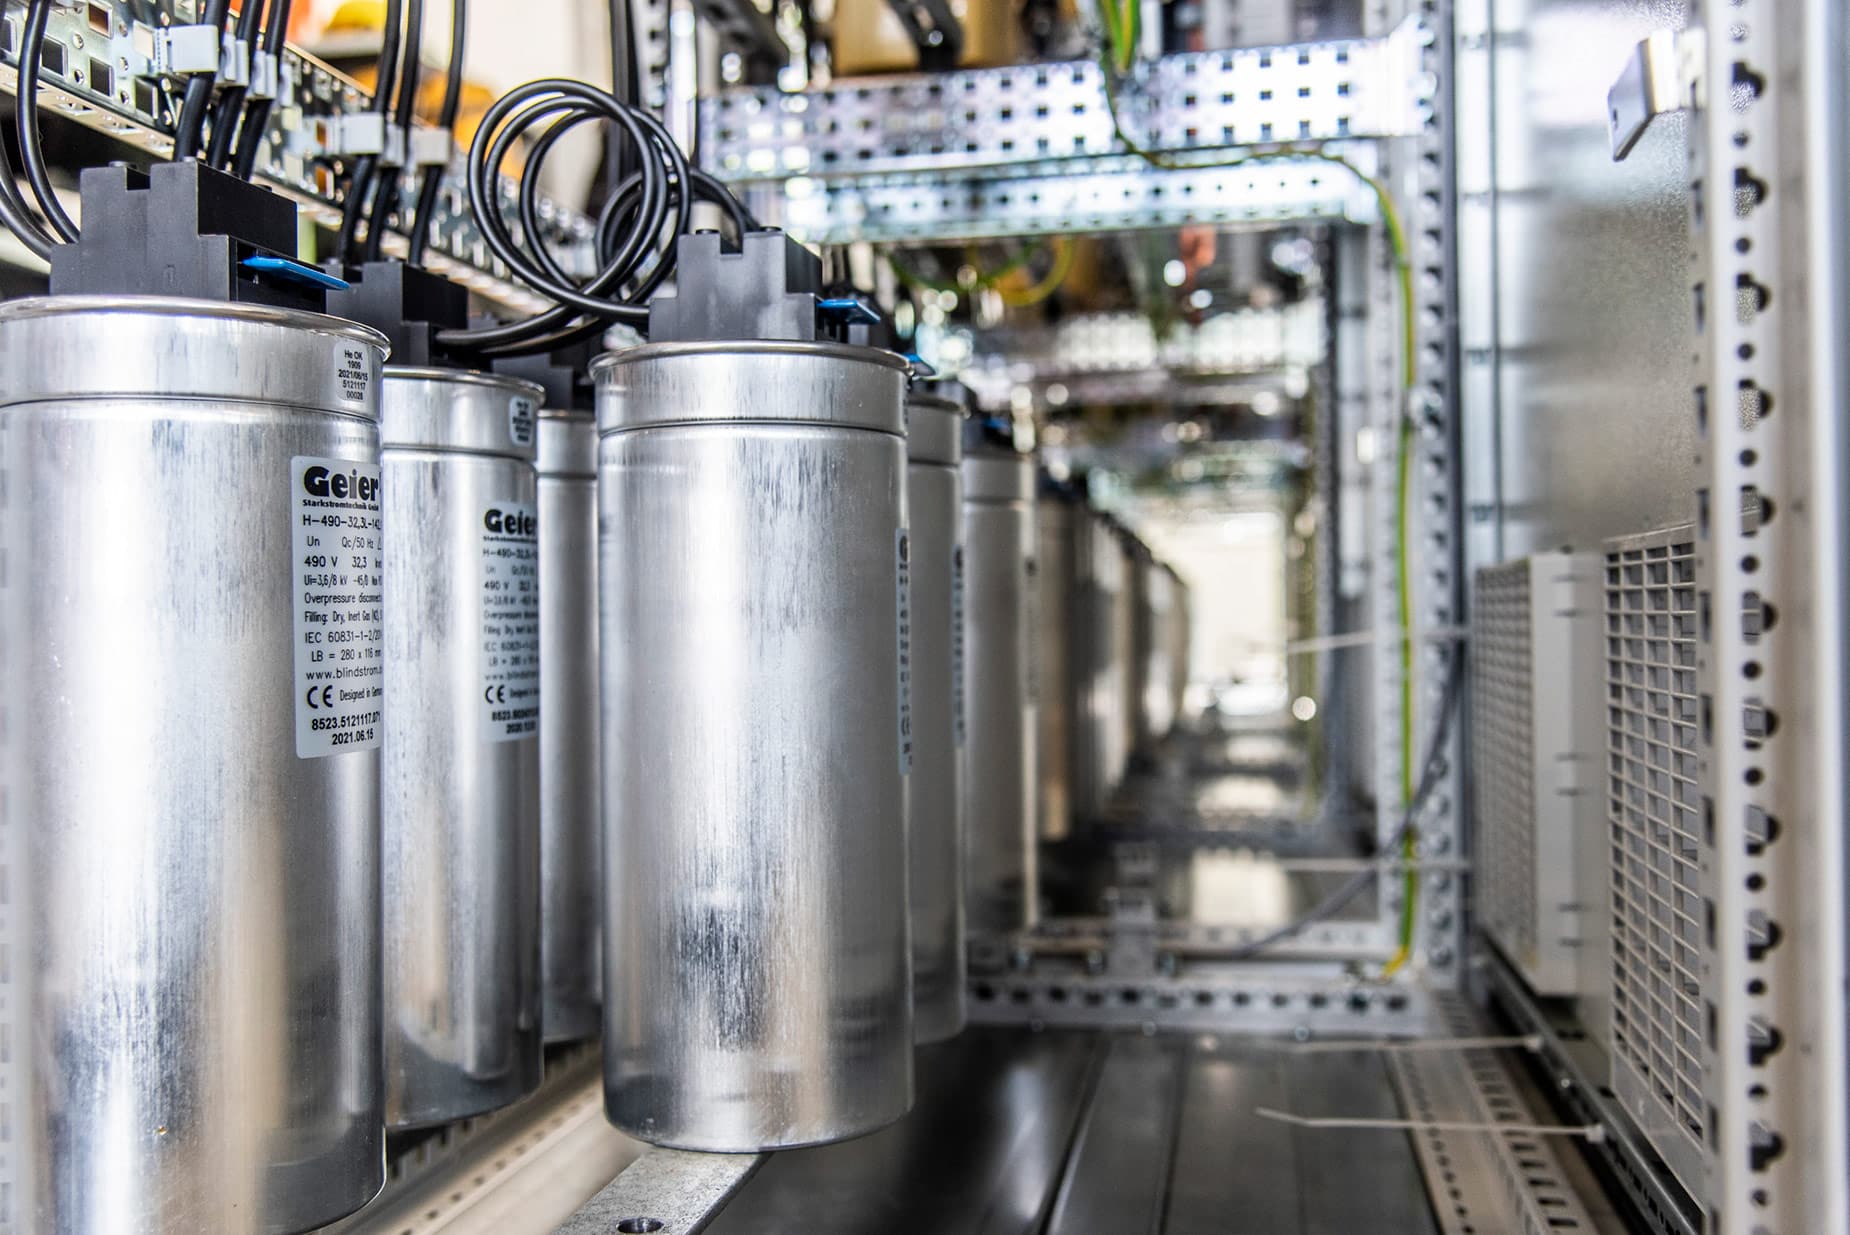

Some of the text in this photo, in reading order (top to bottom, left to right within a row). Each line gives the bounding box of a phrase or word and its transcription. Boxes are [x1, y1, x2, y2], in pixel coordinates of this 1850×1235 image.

[354, 351, 363, 361] OK
[342, 379, 366, 391] 5121117
[303, 465, 379, 502] Geier
[306, 535, 321, 548] Un
[304, 555, 327, 568] 490
[331, 556, 338, 568] V
[351, 555, 368, 569] 32,3
[303, 592, 356, 606] Overpressure
[304, 632, 322, 644] IEC
[311, 650, 324, 663] LB
[340, 648, 355, 661] 280
[331, 728, 374, 746] 2021.06.15
